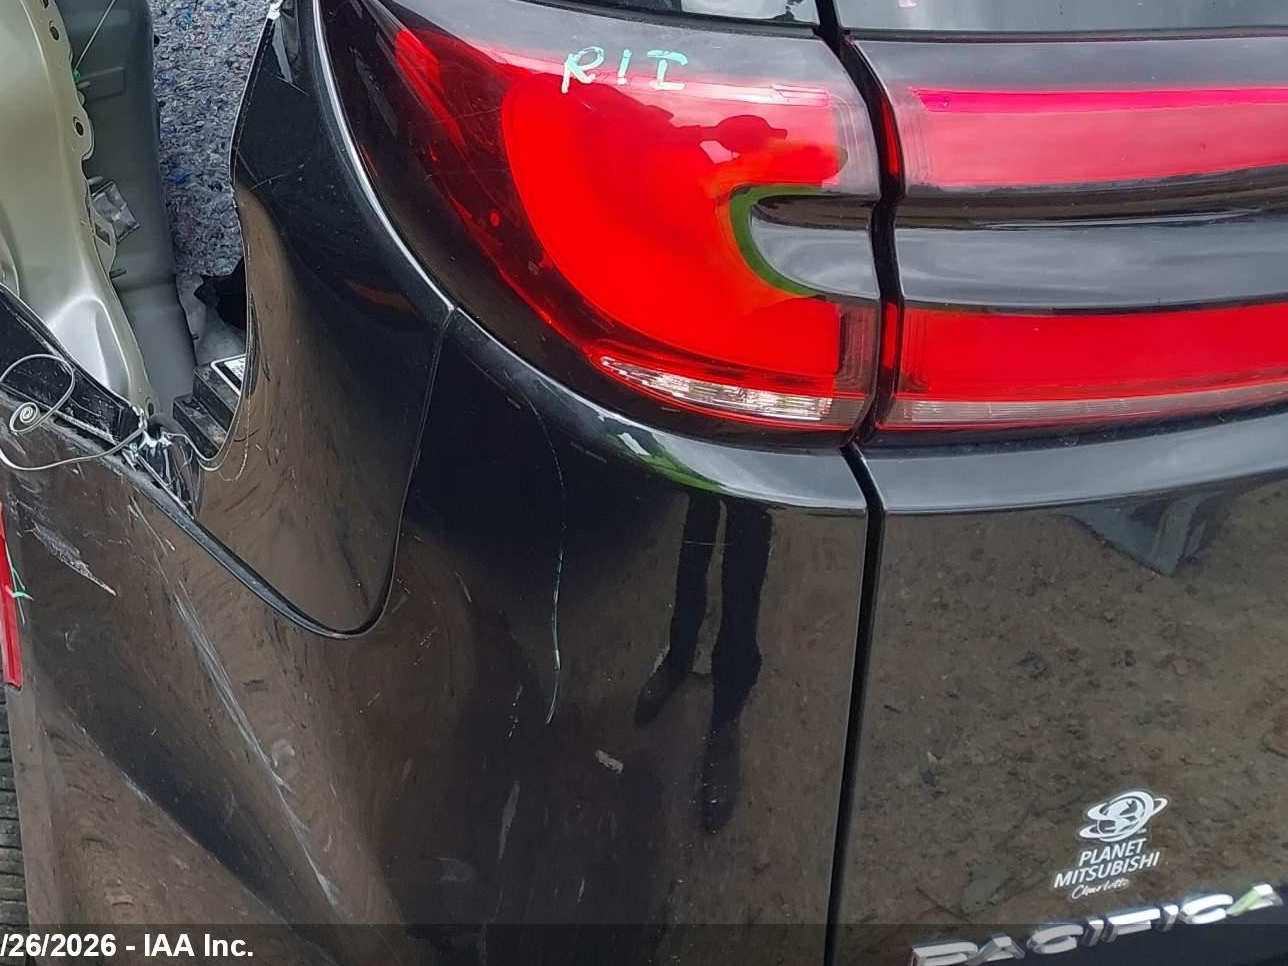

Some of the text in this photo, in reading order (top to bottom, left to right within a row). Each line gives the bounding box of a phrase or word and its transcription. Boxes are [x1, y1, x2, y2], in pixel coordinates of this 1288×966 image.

[1054, 851, 1161, 888] MITSUBISHI
[1078, 838, 1147, 867] PLANET
[908, 883, 1284, 966] PACIFICA
